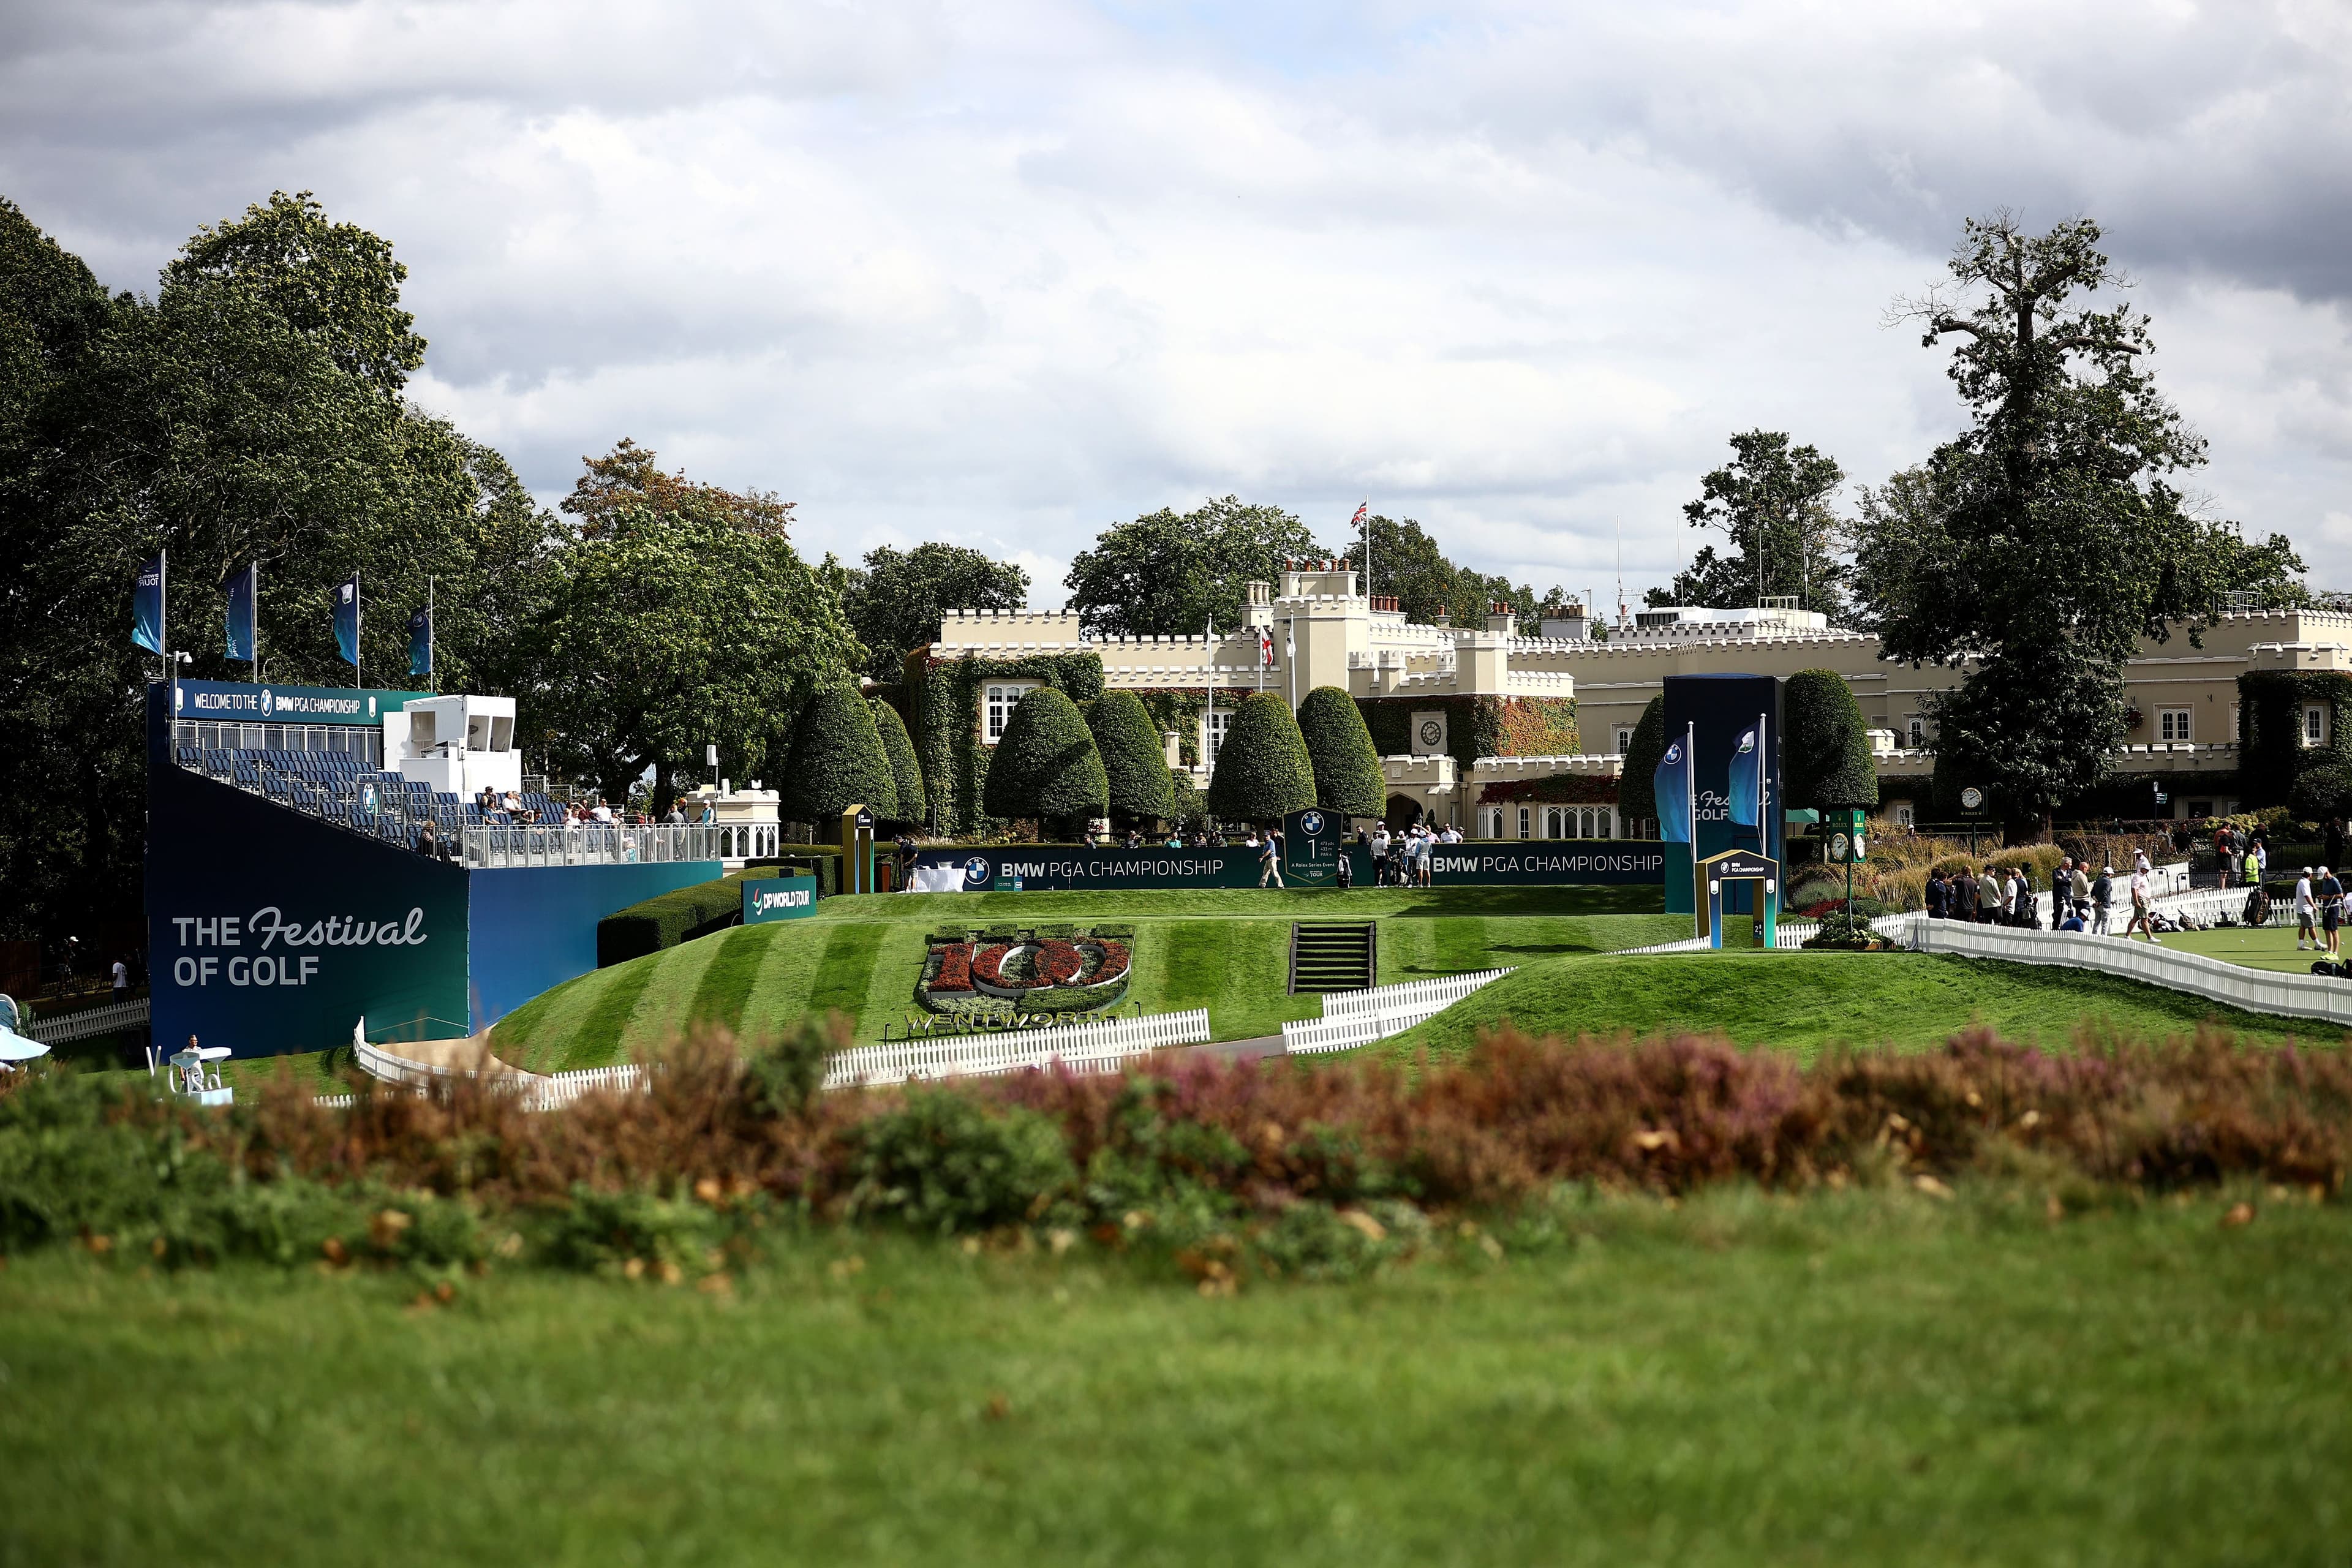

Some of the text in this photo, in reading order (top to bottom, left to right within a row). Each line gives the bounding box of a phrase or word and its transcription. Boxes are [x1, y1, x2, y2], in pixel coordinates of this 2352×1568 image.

[194, 693, 360, 714] WELCOME TO THE BMW PGA CHAMPIONSHIP
[1307, 839, 1315, 859] 1
[1001, 859, 1223, 877] BMW PGA CHAMPIONSHIP
[1433, 855, 1662, 872] BMW PGA CHAMPIONSHIP
[763, 890, 810, 910] DP WORLD TOUR
[172, 906, 428, 951] THE Festival
[174, 956, 319, 986] OF GOLF
